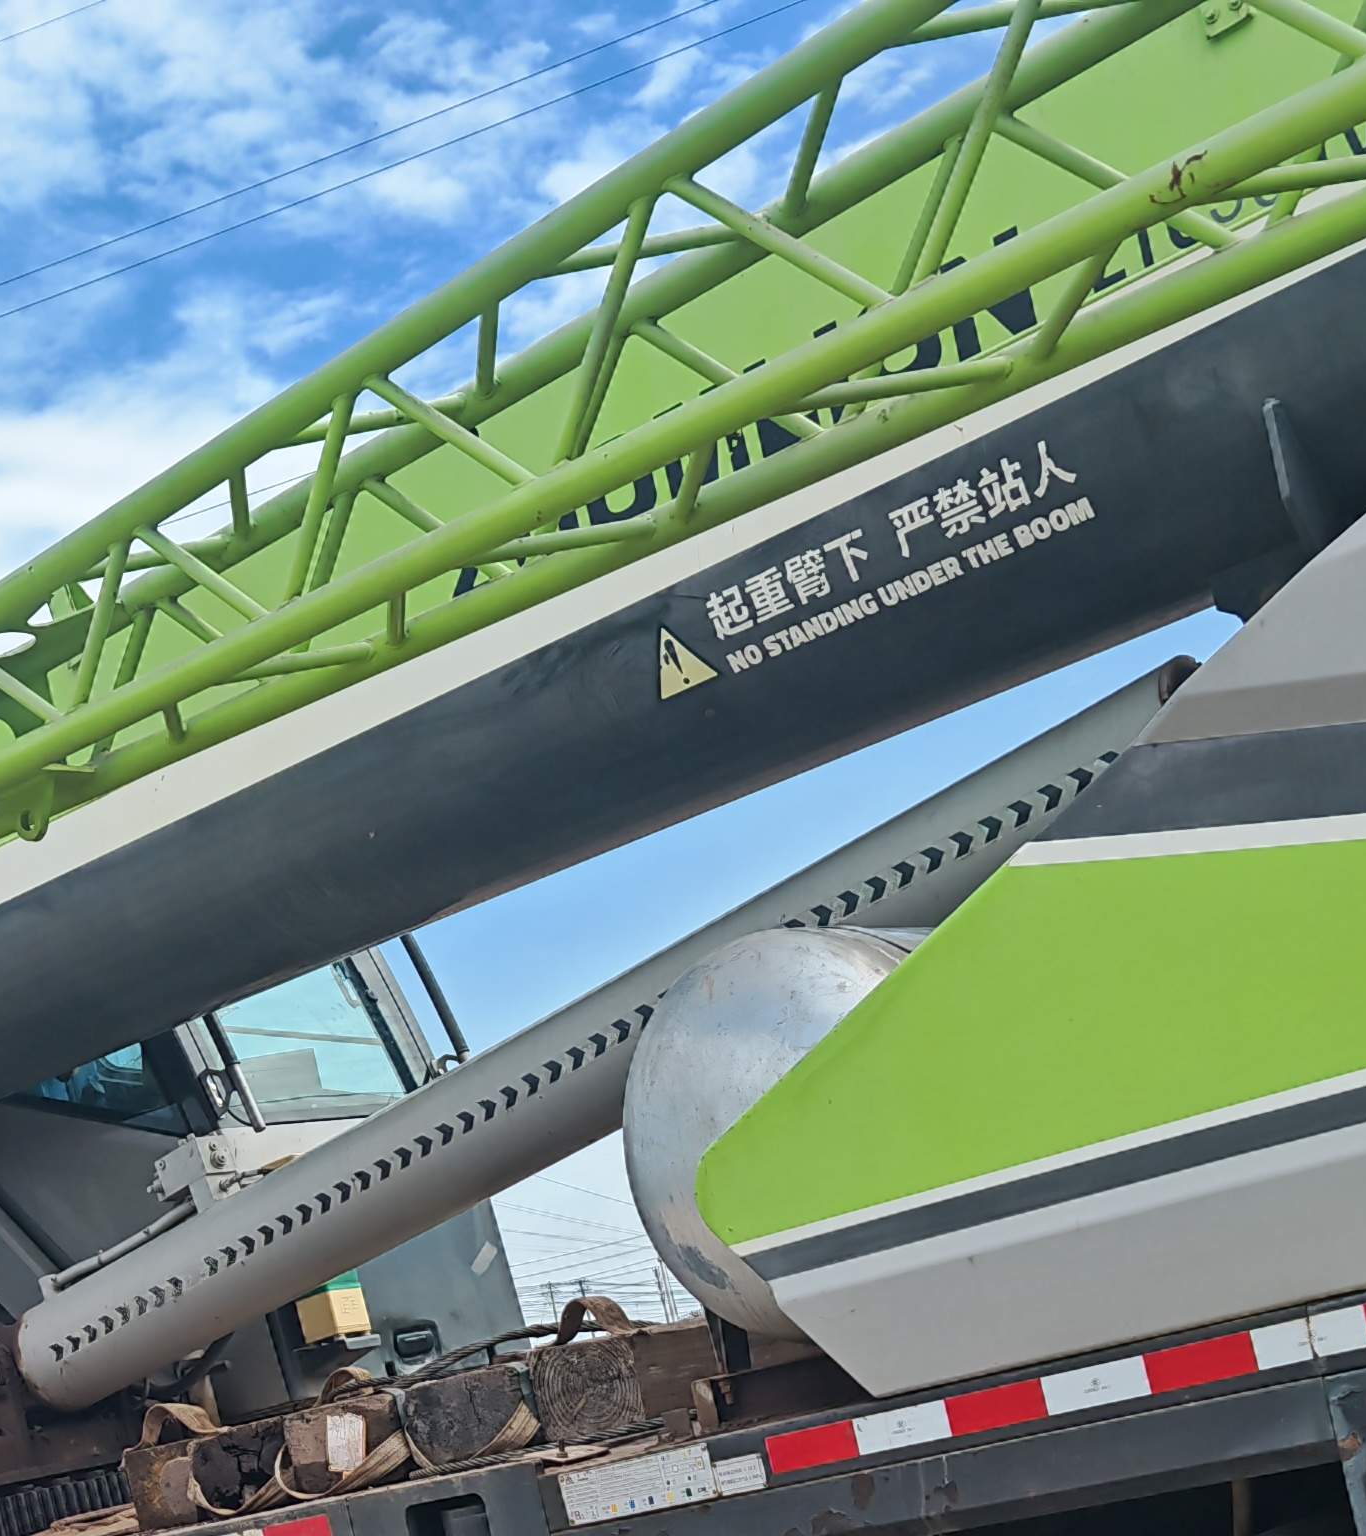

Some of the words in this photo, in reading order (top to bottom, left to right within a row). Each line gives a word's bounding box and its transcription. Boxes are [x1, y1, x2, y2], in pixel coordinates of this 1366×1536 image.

[706, 529, 868, 640] 起重臂下
[888, 440, 1077, 558] 严禁站人
[726, 645, 763, 673] NO
[763, 594, 878, 658] STANDING
[877, 558, 963, 606] UNDER
[961, 533, 1014, 569] THE
[1013, 497, 1095, 549] BOOM
